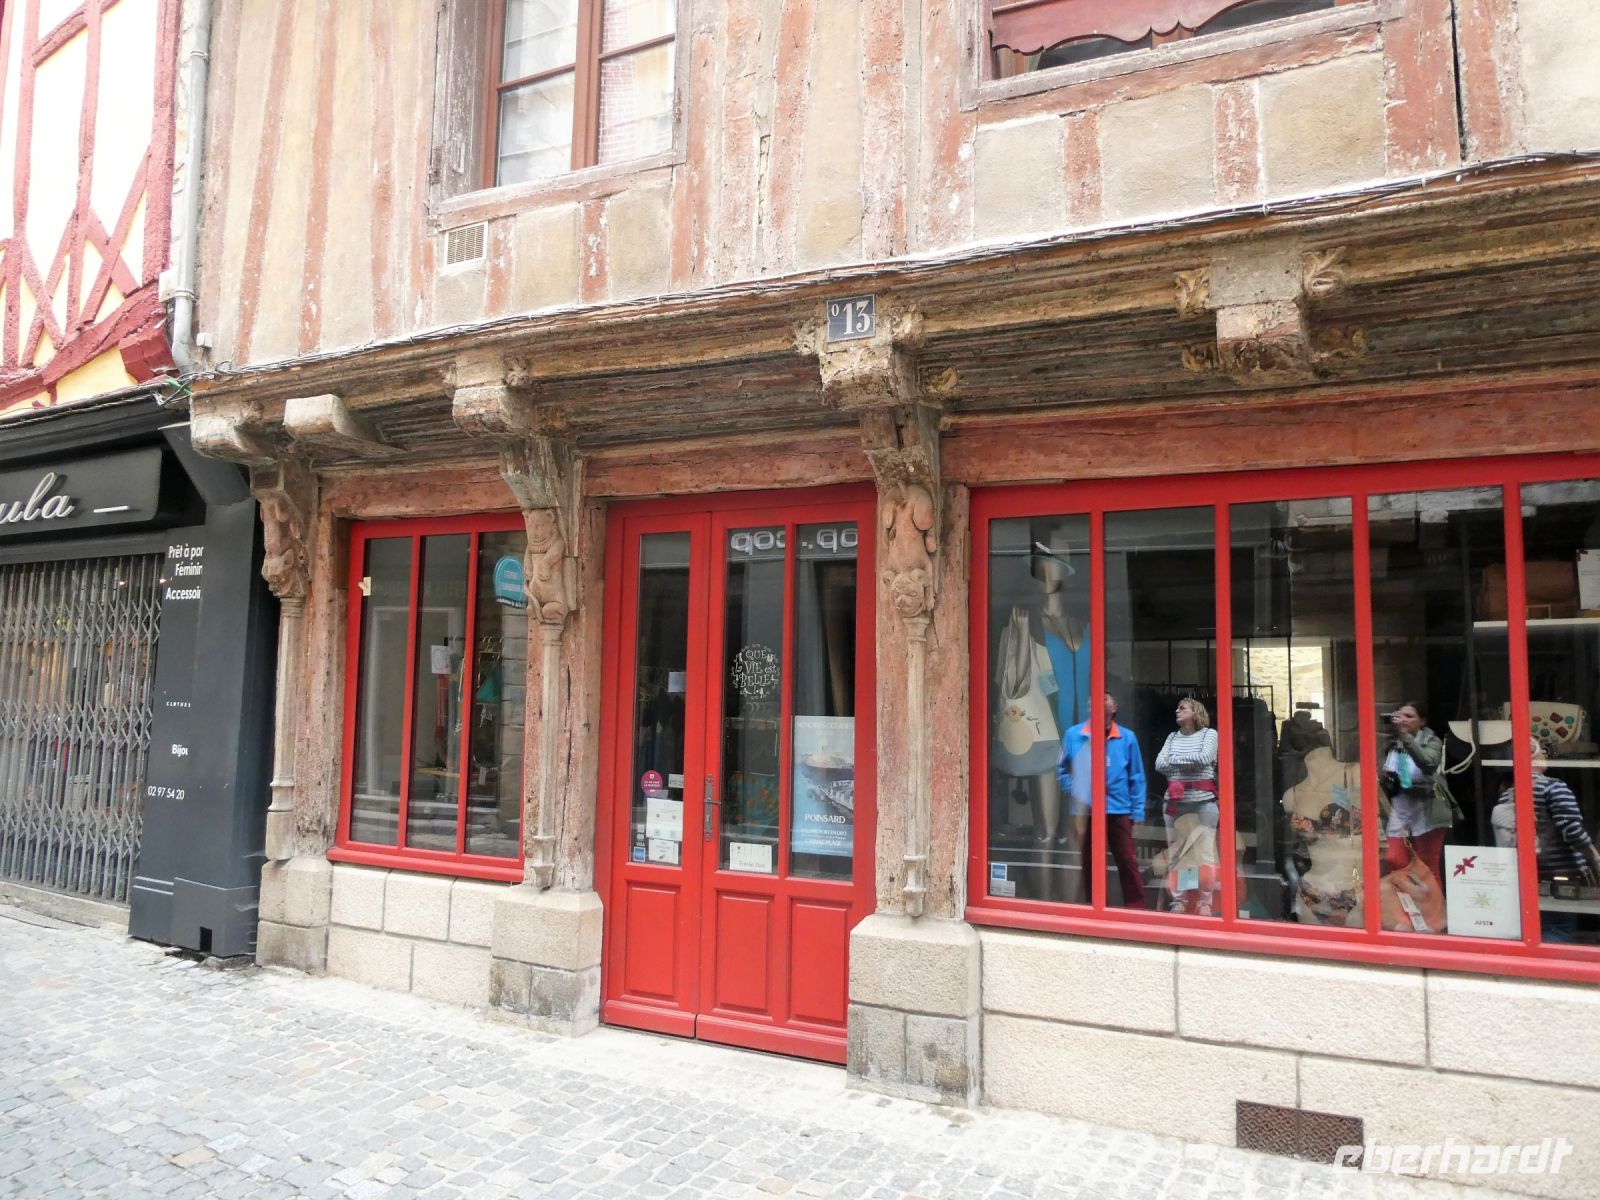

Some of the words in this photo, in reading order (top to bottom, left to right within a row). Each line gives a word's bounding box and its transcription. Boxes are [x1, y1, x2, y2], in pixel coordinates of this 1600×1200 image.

[168, 544, 183, 559] Prêt
[184, 542, 190, 558] à
[147, 785, 157, 797] 02
[157, 786, 166, 798] 97
[166, 787, 175, 799] 54
[175, 789, 185, 800] 20
[804, 812, 846, 824] POINSARD
